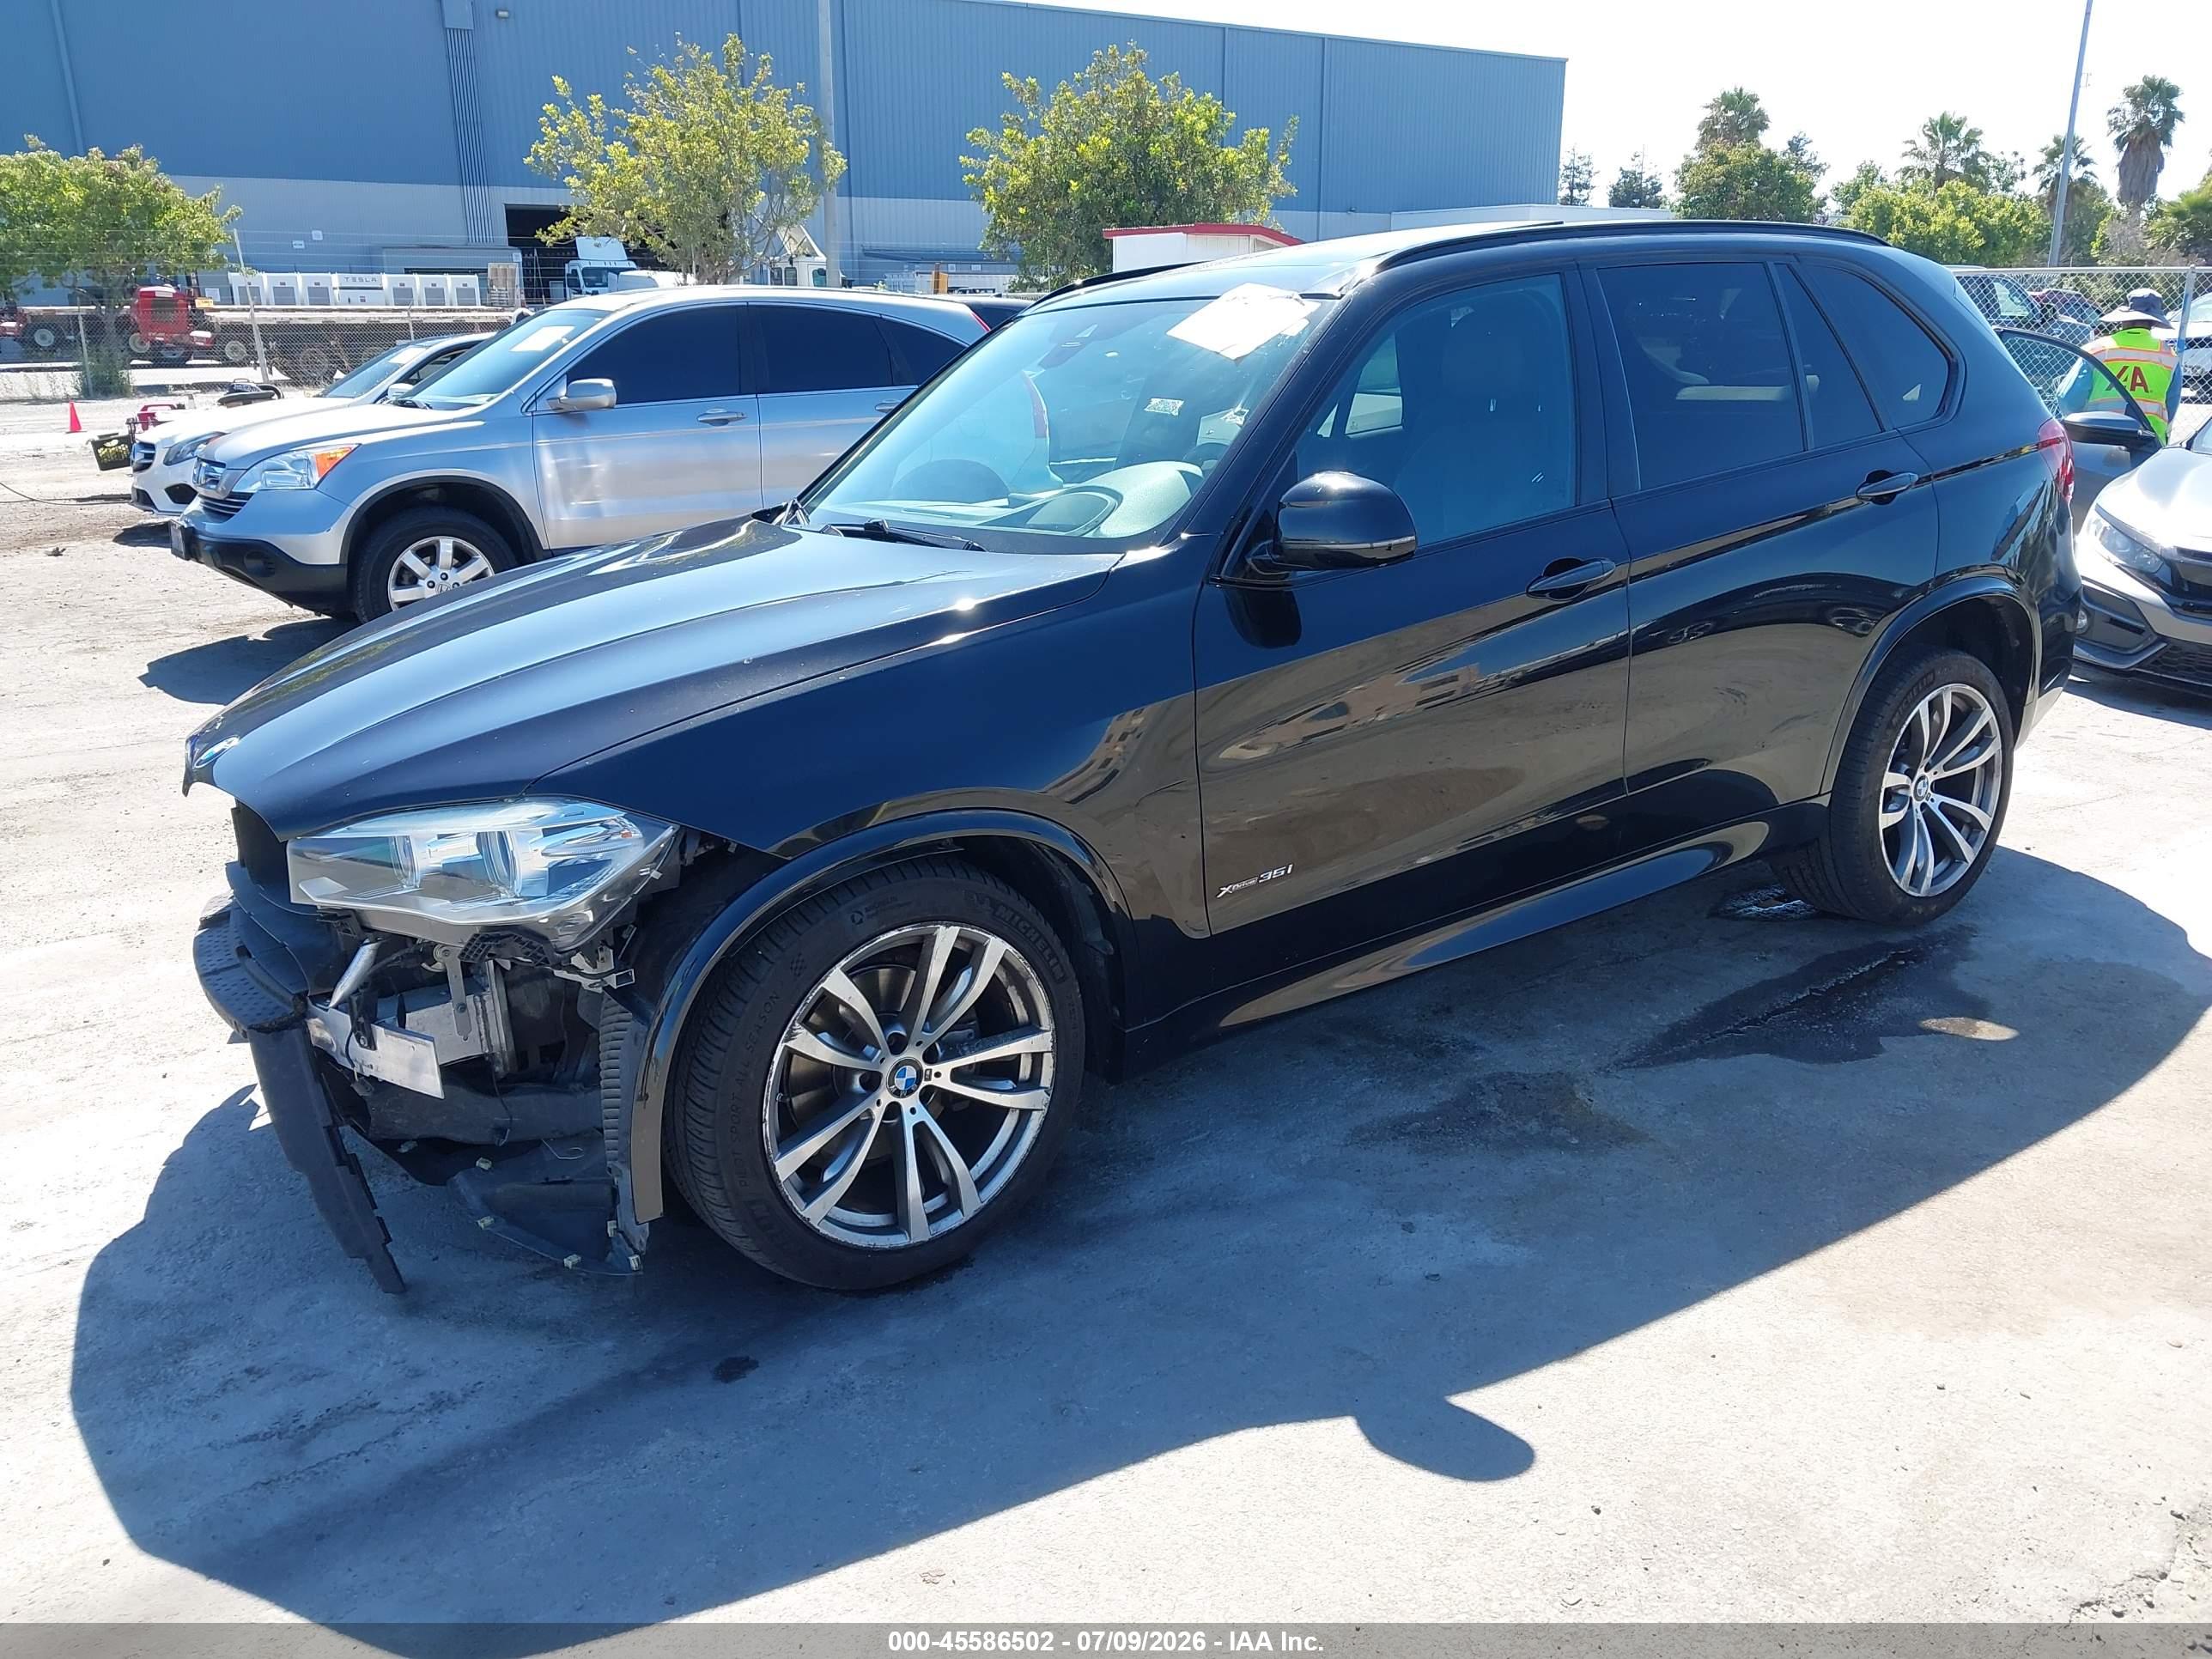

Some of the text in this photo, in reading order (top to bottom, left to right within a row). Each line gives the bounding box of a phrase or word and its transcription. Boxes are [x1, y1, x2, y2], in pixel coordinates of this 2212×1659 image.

[994, 902, 1066, 984] MICHELIN
[745, 992, 781, 1053] SEASON
[729, 1091, 742, 1143] SPORT
[732, 1151, 749, 1188] PILOT
